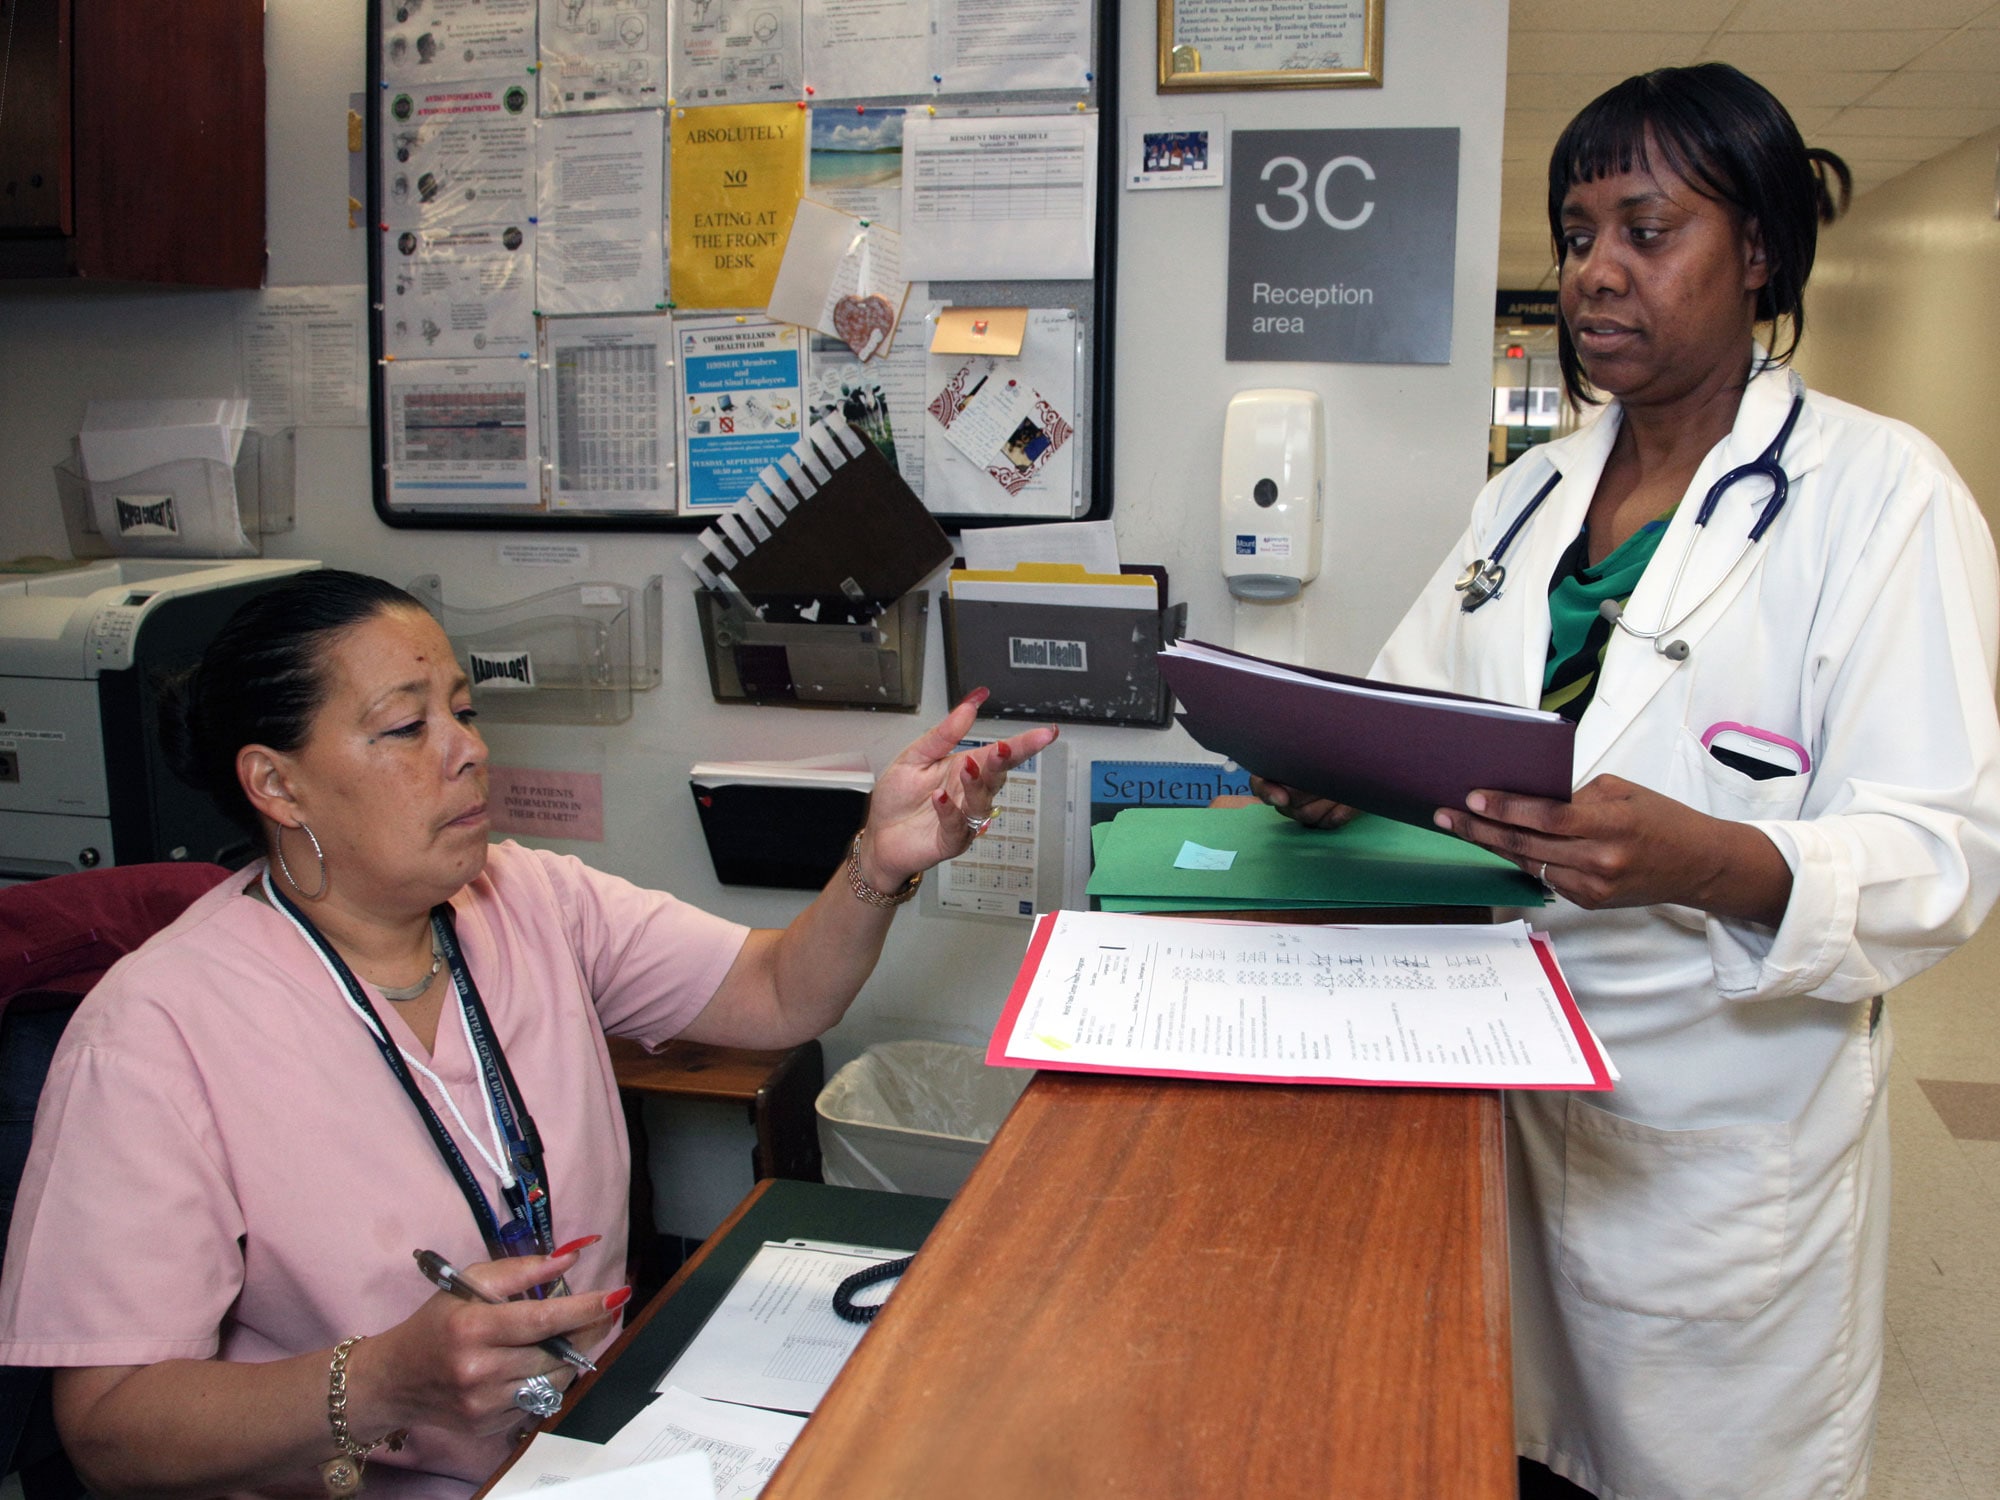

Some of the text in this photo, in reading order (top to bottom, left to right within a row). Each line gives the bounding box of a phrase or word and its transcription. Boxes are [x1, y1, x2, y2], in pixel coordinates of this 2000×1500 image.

[686, 124, 788, 145] ABSOLUTELY
[1008, 132, 1048, 141] SCHEDULE
[723, 170, 748, 187] NO
[1255, 155, 1376, 231] 3C
[693, 210, 777, 229] EATING AT
[692, 232, 778, 249] THE FRONT
[714, 254, 755, 270] DESK
[1252, 282, 1374, 309] Reception
[1252, 316, 1305, 334] area
[702, 330, 777, 344] CHOOSE WELLNESS
[714, 341, 765, 352] HEALTH FAIR
[742, 357, 778, 367] Members
[734, 368, 749, 377] and
[698, 376, 787, 389] Mount Sinai Employees
[726, 457, 769, 467] SEPTEMBER
[1237, 539, 1256, 548] Mount
[1237, 547, 1252, 555] Sinai
[1012, 638, 1083, 668] Mental Health
[470, 654, 531, 686] RADIOLOGY
[510, 785, 575, 799] PUT PATIENTS
[504, 796, 582, 811] INFORMATION IN
[508, 809, 535, 819] THEIR
[433, 916, 455, 959] DIVISION
[453, 966, 514, 1128] NYPD INTELLIGENCE DIVISION
